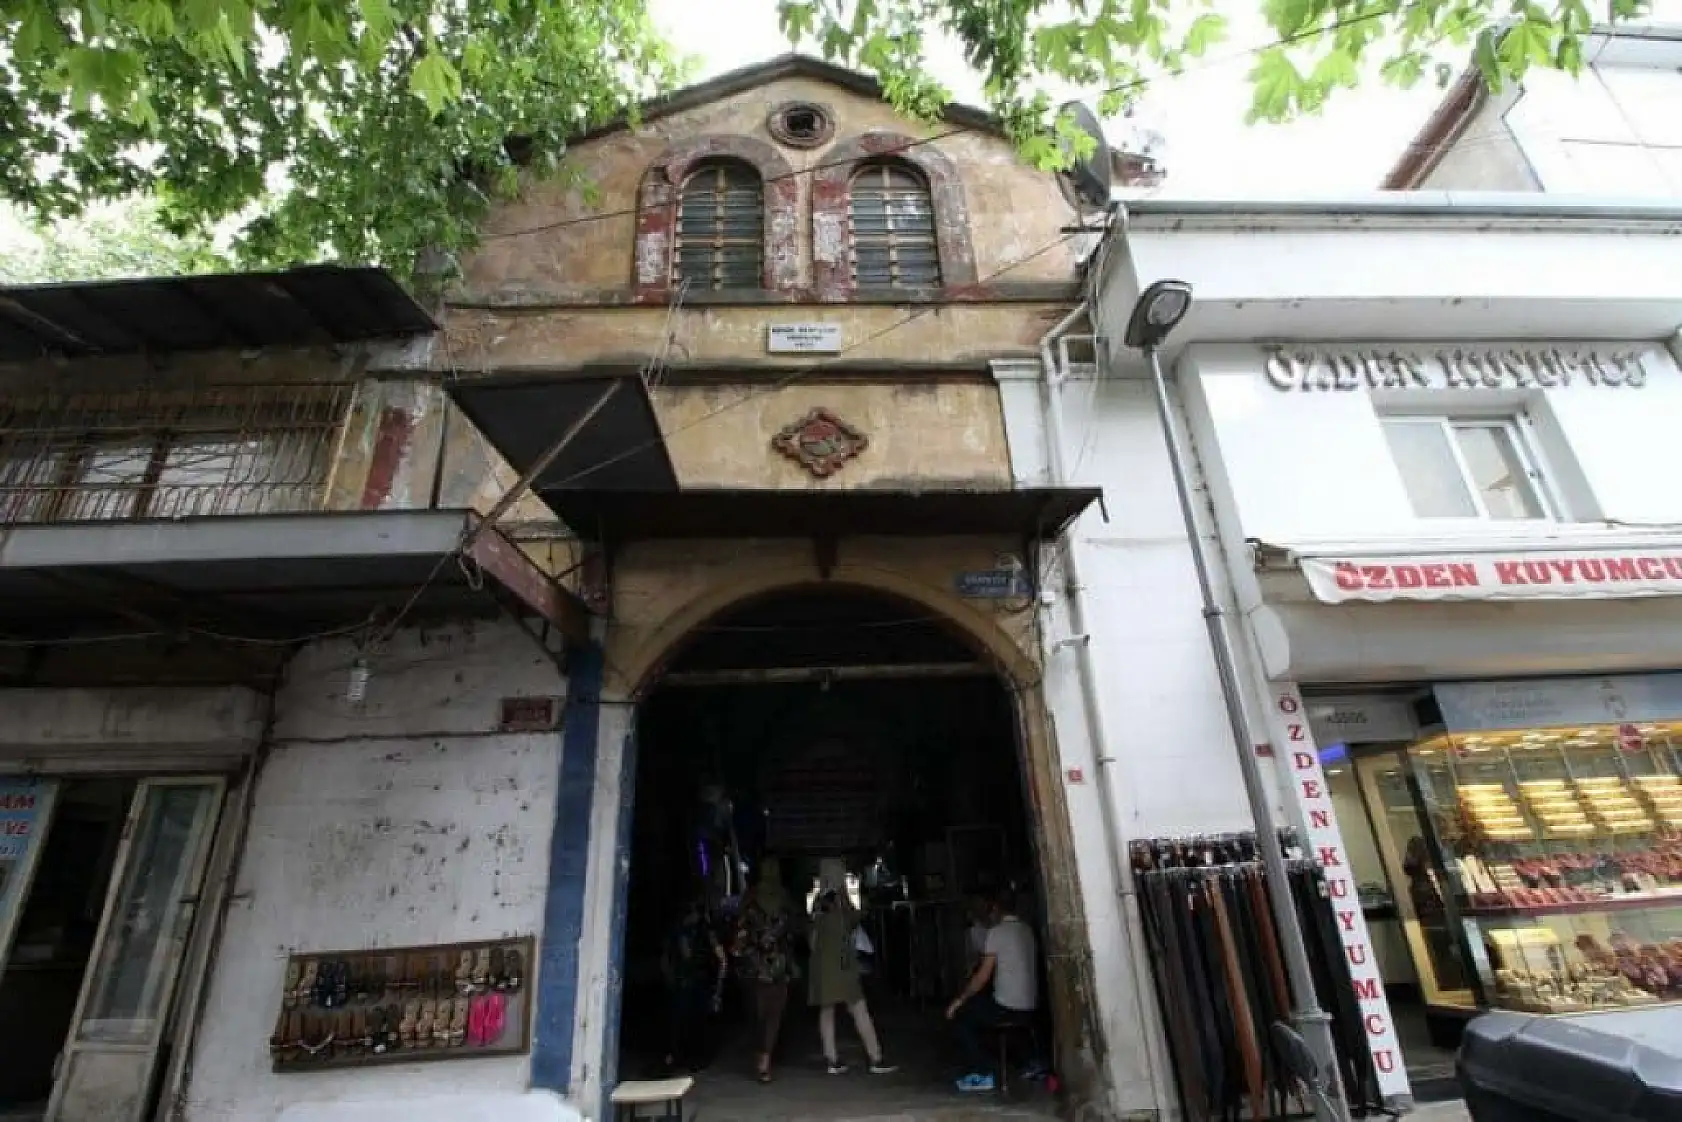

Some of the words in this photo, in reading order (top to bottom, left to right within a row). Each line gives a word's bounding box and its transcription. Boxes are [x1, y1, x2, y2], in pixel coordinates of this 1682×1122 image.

[1335, 561, 1480, 591] ÖZDEN
[1494, 557, 1682, 585] KUYUMCU
[1279, 692, 1332, 829] ÖZDEN
[1317, 846, 1393, 1074] KUYUMCU
